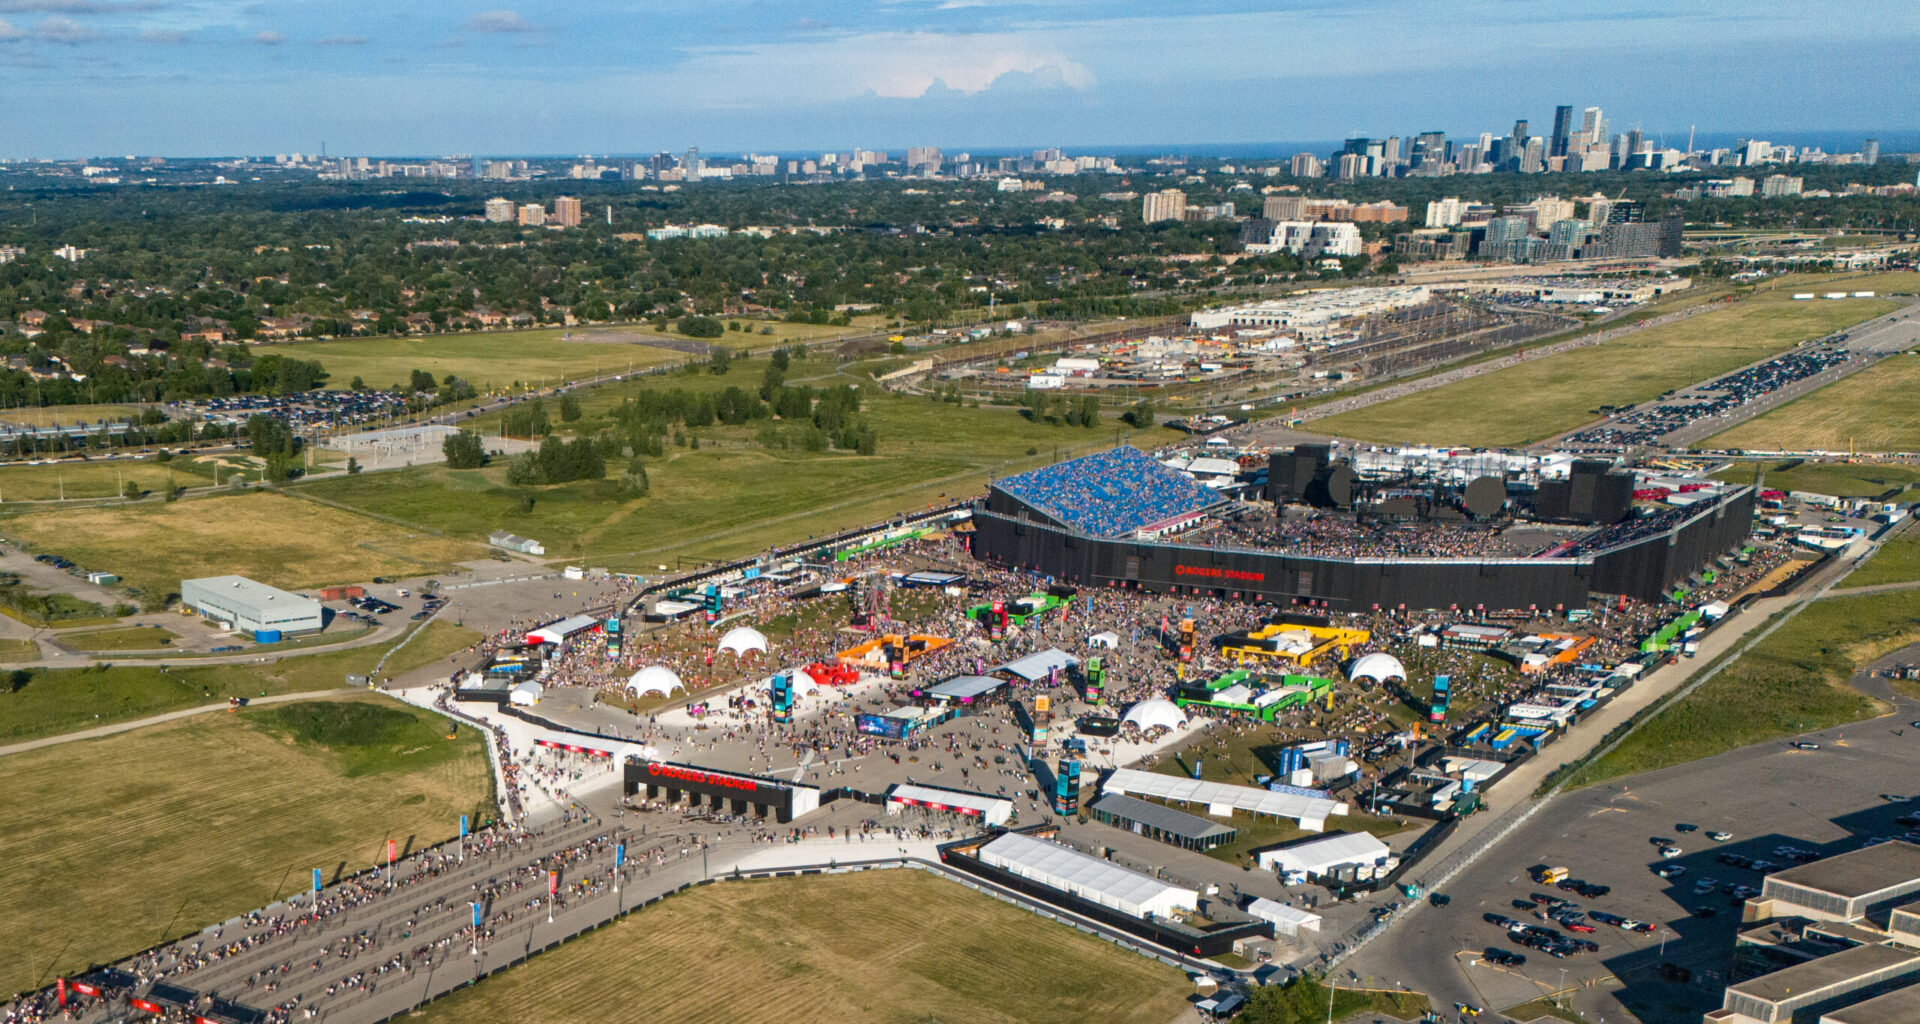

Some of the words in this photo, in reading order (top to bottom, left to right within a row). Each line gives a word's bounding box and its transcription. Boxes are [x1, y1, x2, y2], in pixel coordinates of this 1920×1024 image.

[1186, 566, 1222, 577] ROGERS
[1224, 570, 1264, 581] STADIUM
[662, 766, 705, 783] ROGERS
[708, 774, 756, 791] STADIUM
